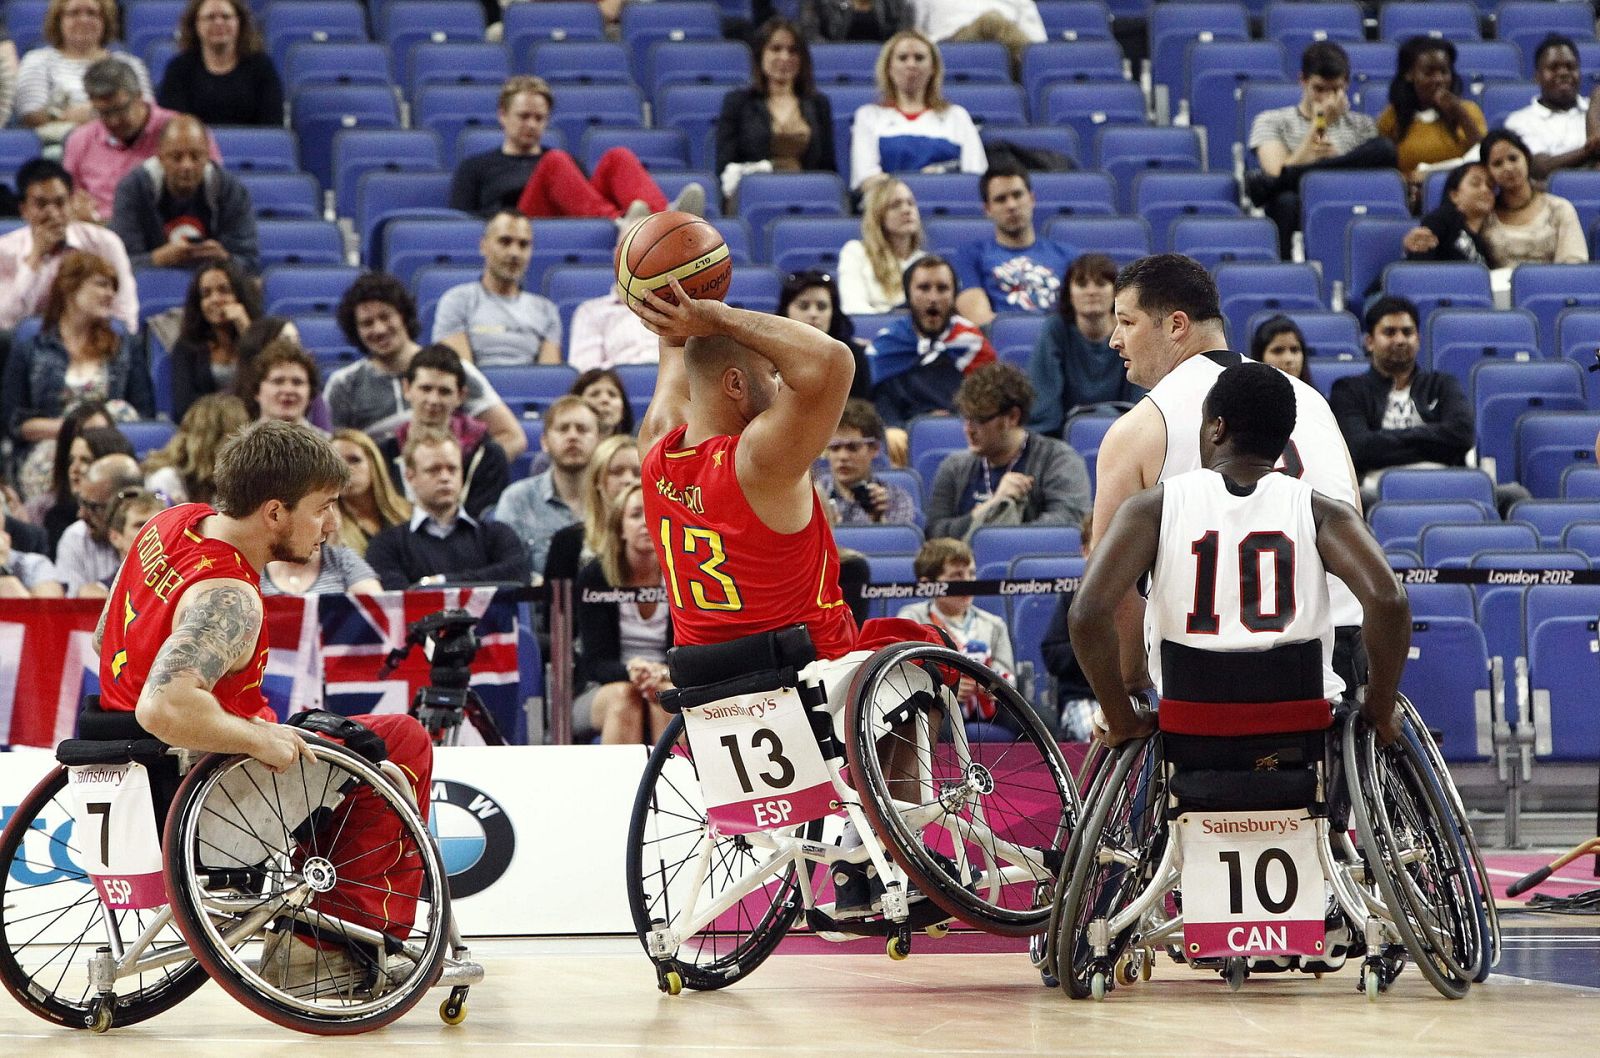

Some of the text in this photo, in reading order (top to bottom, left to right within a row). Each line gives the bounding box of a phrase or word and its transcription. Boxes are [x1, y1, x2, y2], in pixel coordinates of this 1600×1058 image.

[694, 257, 711, 269] GL7
[660, 517, 742, 610] 13
[1406, 569, 1439, 583] 2012
[1001, 577, 1082, 595] London 201
[1186, 530, 1297, 635] 10
[1488, 569, 1575, 584] London 2012
[582, 588, 635, 602] London
[861, 582, 949, 598] London 2012
[702, 698, 777, 720] Sainsbury's
[720, 728, 795, 793] 13
[430, 782, 500, 820] MW
[753, 799, 792, 827] ESP
[86, 802, 111, 868] 7
[1202, 817, 1299, 834] Sainsbury's
[103, 879, 132, 904] ESP
[1219, 848, 1298, 914] 10
[1227, 926, 1287, 952] CAN
